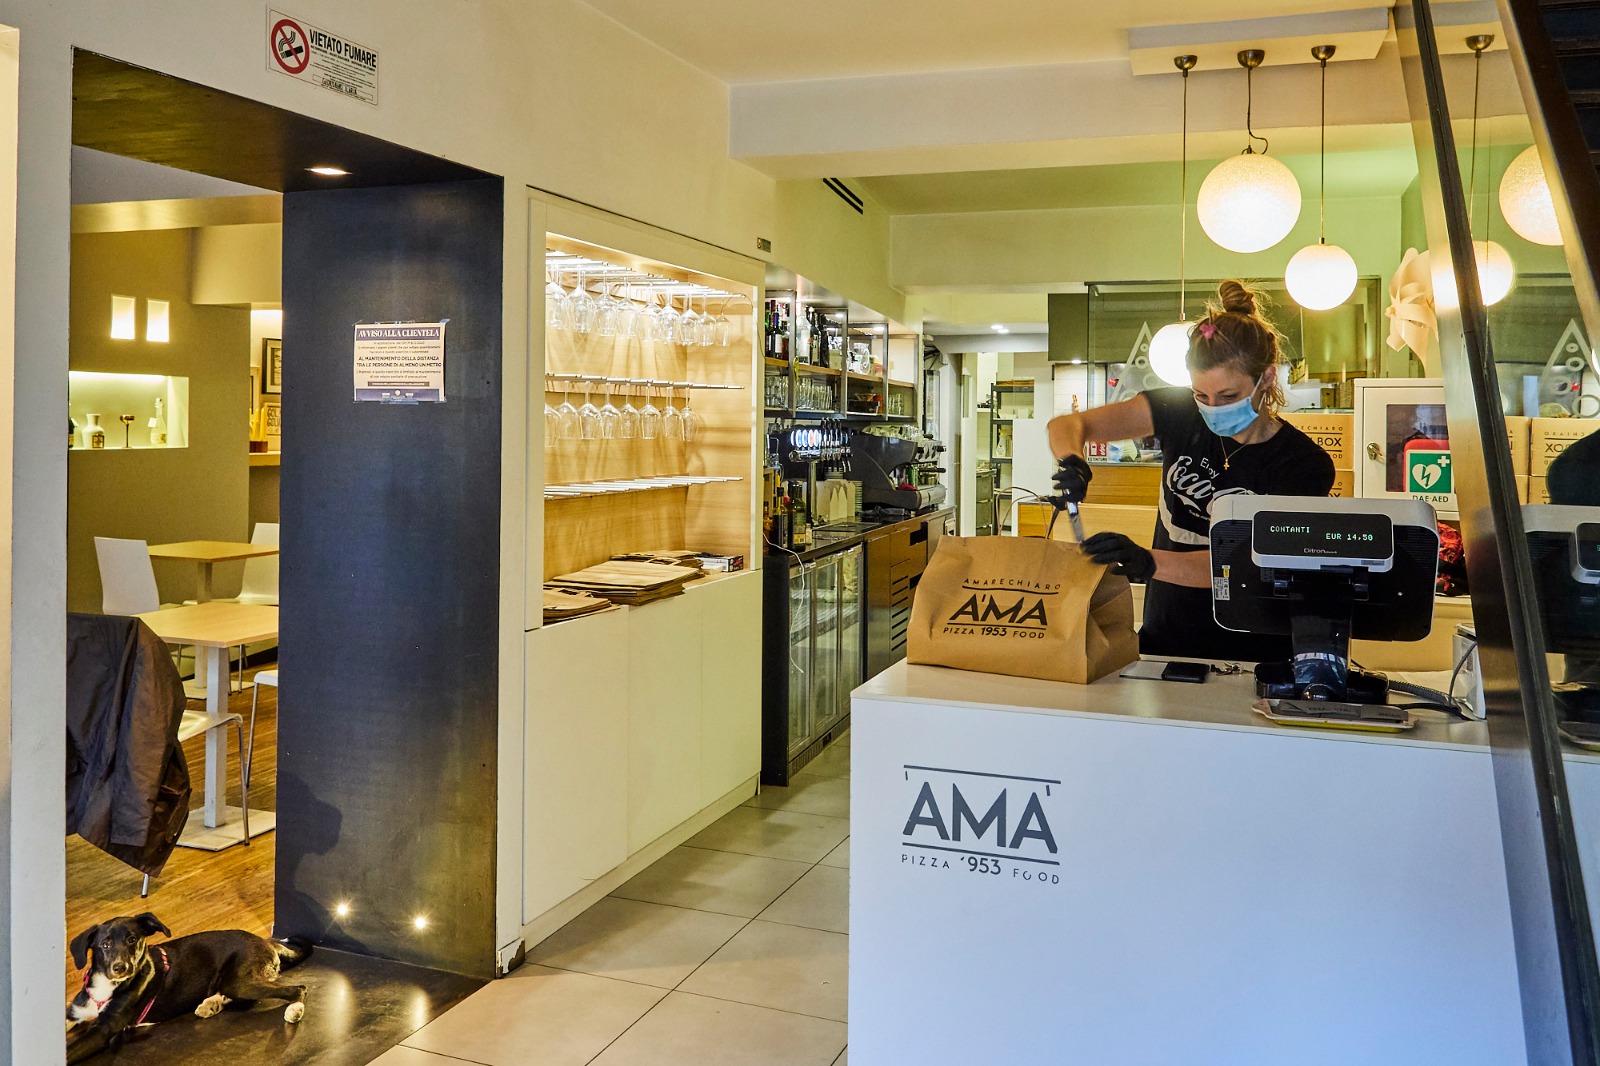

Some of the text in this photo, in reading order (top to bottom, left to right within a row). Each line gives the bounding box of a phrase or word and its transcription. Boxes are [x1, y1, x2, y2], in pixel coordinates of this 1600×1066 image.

[309, 29, 342, 54] VIETATO
[344, 42, 377, 68] FUMARE
[358, 328, 439, 338] AVVISO ALLA CLIENTELA
[1317, 437, 1342, 447] BOX
[1269, 525, 1311, 534] CONTANTI
[1325, 532, 1342, 541] EUR
[1303, 547, 1325, 555] Ditron
[948, 593, 1048, 627] A'MA
[942, 626, 1045, 639] PIZZA 1953 FOOD
[901, 853, 950, 870] PIZZA
[1012, 868, 1060, 885] FOOD
